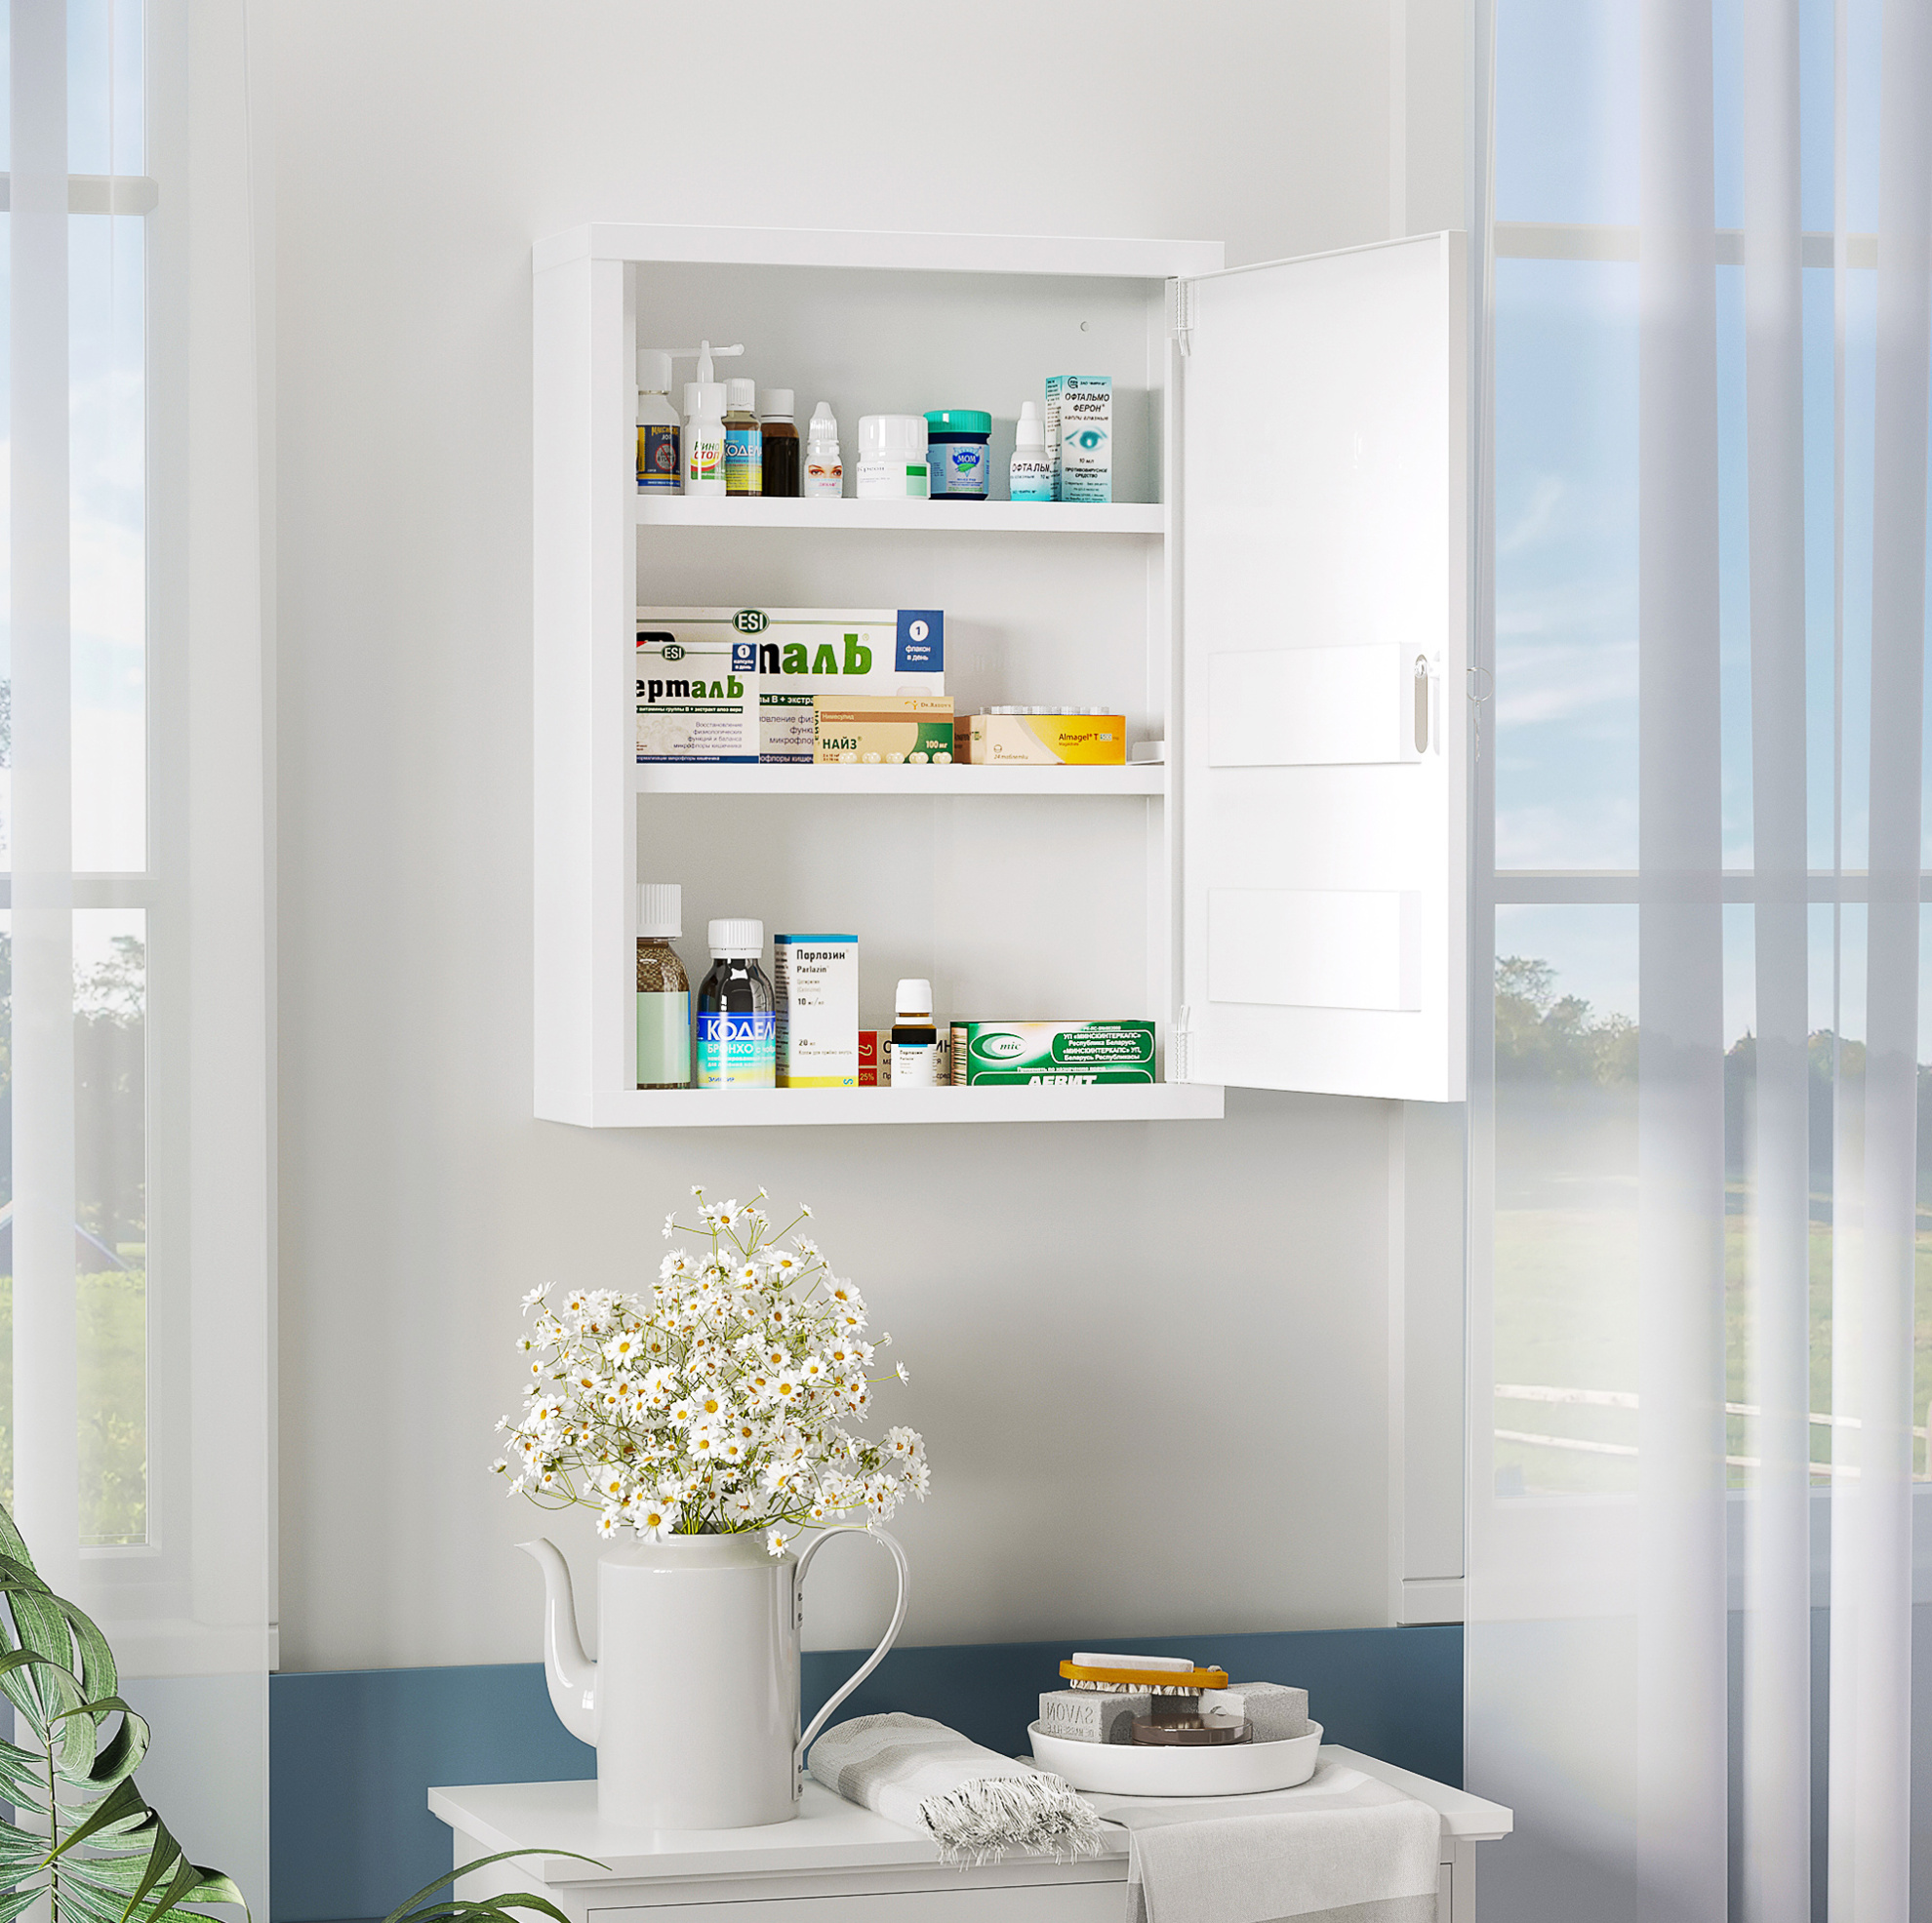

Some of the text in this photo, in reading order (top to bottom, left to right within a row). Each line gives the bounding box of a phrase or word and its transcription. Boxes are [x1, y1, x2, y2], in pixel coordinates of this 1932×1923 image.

[739, 614, 763, 630] ESI
[664, 648, 682, 659] ESI
[823, 736, 857, 749] НАЙЗ
[1059, 734, 1089, 742] Almagel
[999, 1042, 1022, 1051] mic
